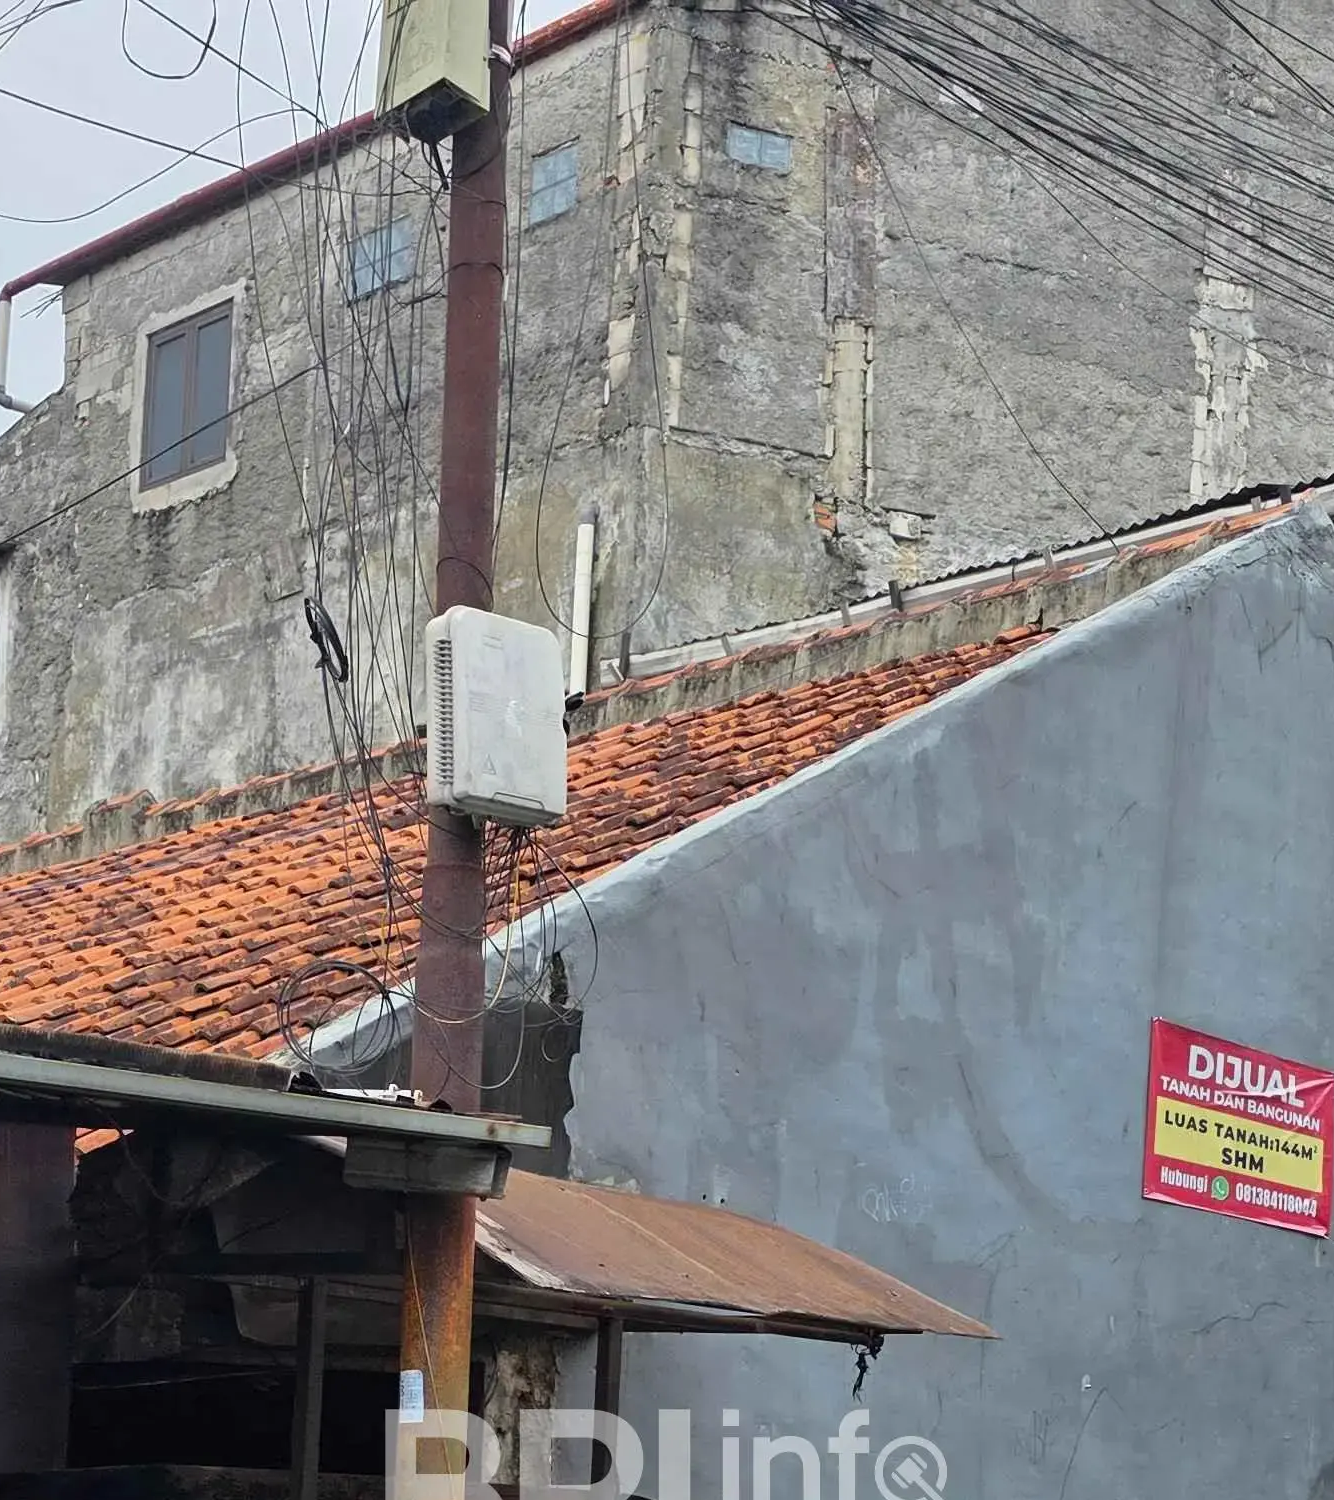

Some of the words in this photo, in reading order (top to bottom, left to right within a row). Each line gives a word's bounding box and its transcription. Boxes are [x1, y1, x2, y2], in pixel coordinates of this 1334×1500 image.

[1188, 1044, 1305, 1108] DIJUAL
[1159, 1075, 1211, 1102] TANAH
[1213, 1090, 1245, 1112] DAN
[1247, 1099, 1320, 1132] BANGUNAN
[1164, 1110, 1208, 1134] LUAS
[1221, 1147, 1265, 1173] SHM
[1160, 1166, 1208, 1193] Hubungi
